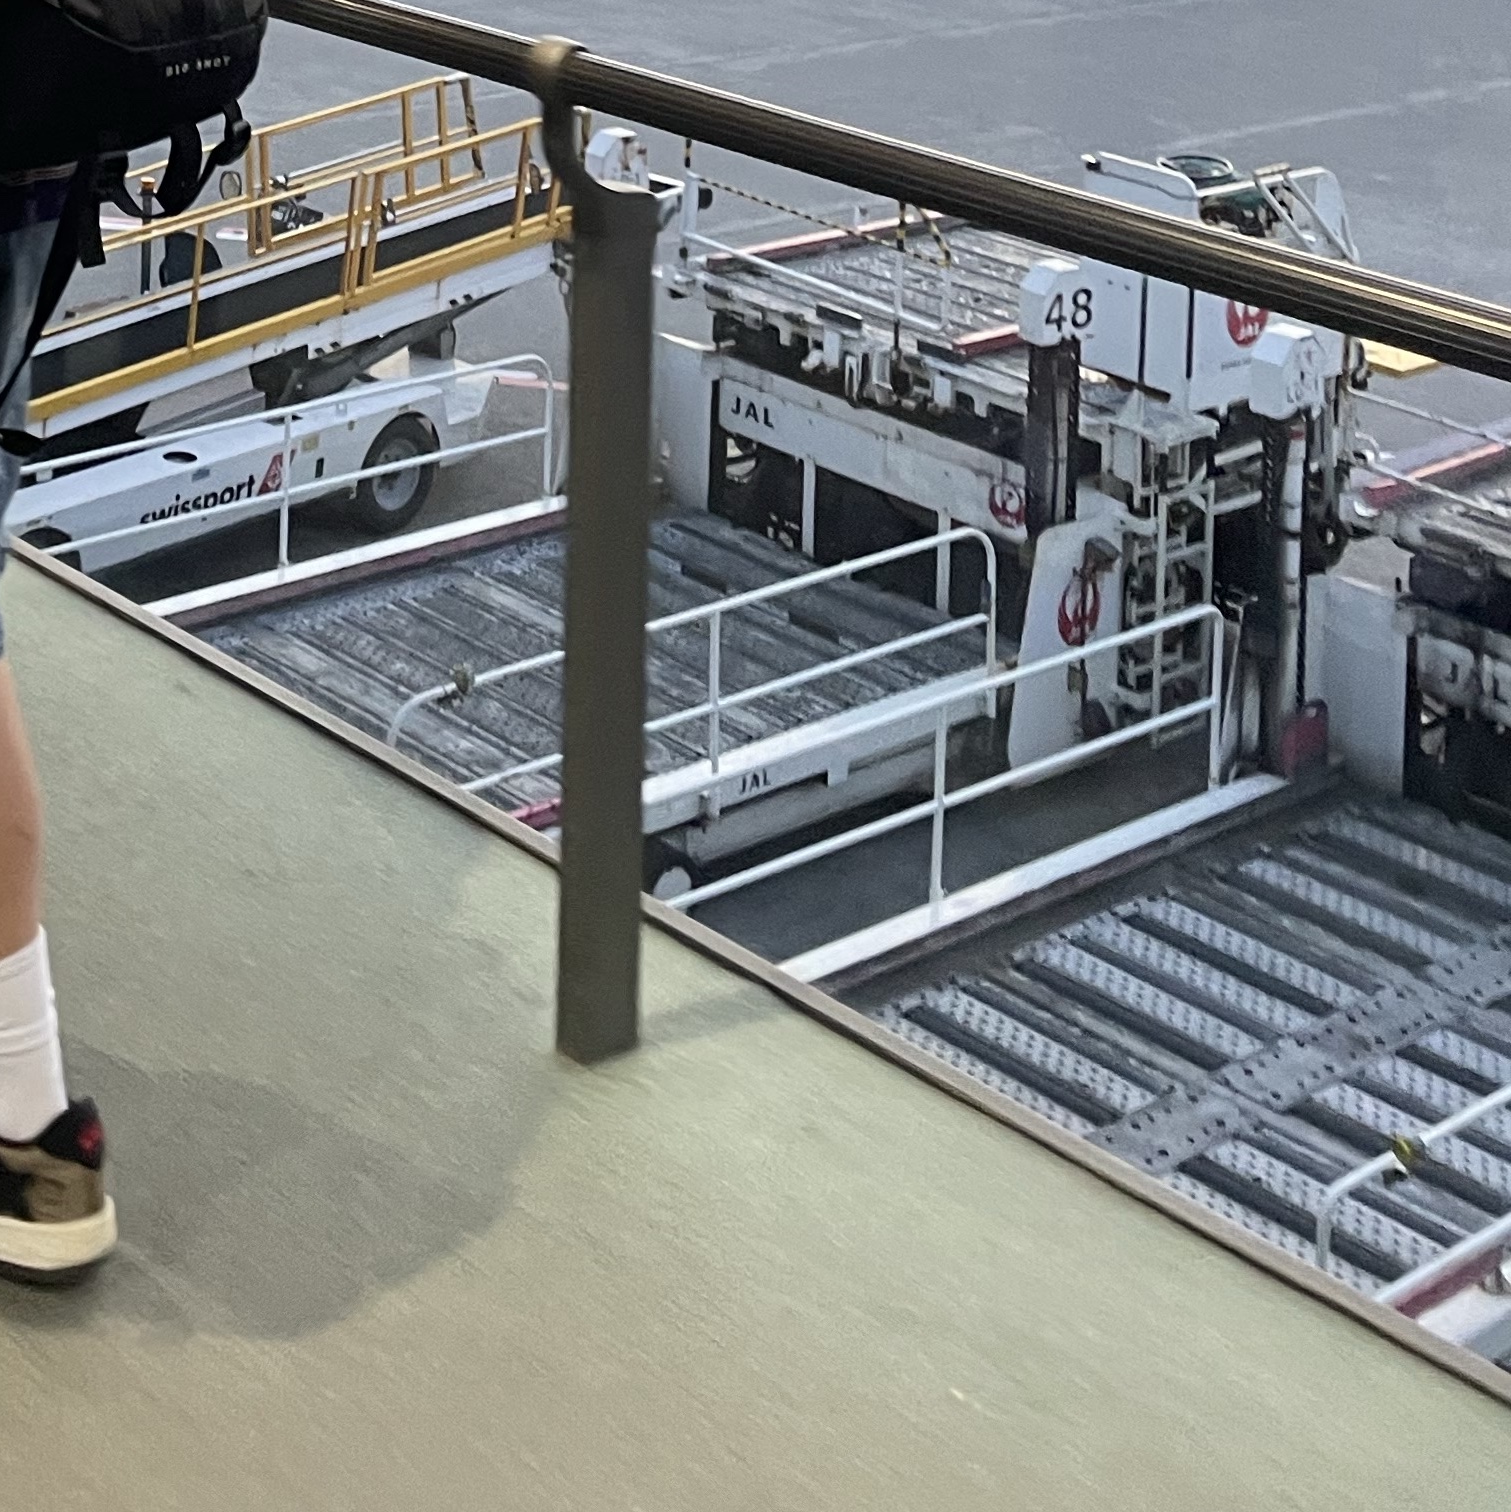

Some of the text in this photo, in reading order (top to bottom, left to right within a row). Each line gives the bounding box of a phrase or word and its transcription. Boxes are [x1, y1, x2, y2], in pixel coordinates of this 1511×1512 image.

[1045, 288, 1092, 332] 48
[731, 396, 774, 429] JAL
[739, 768, 771, 795] JAL
